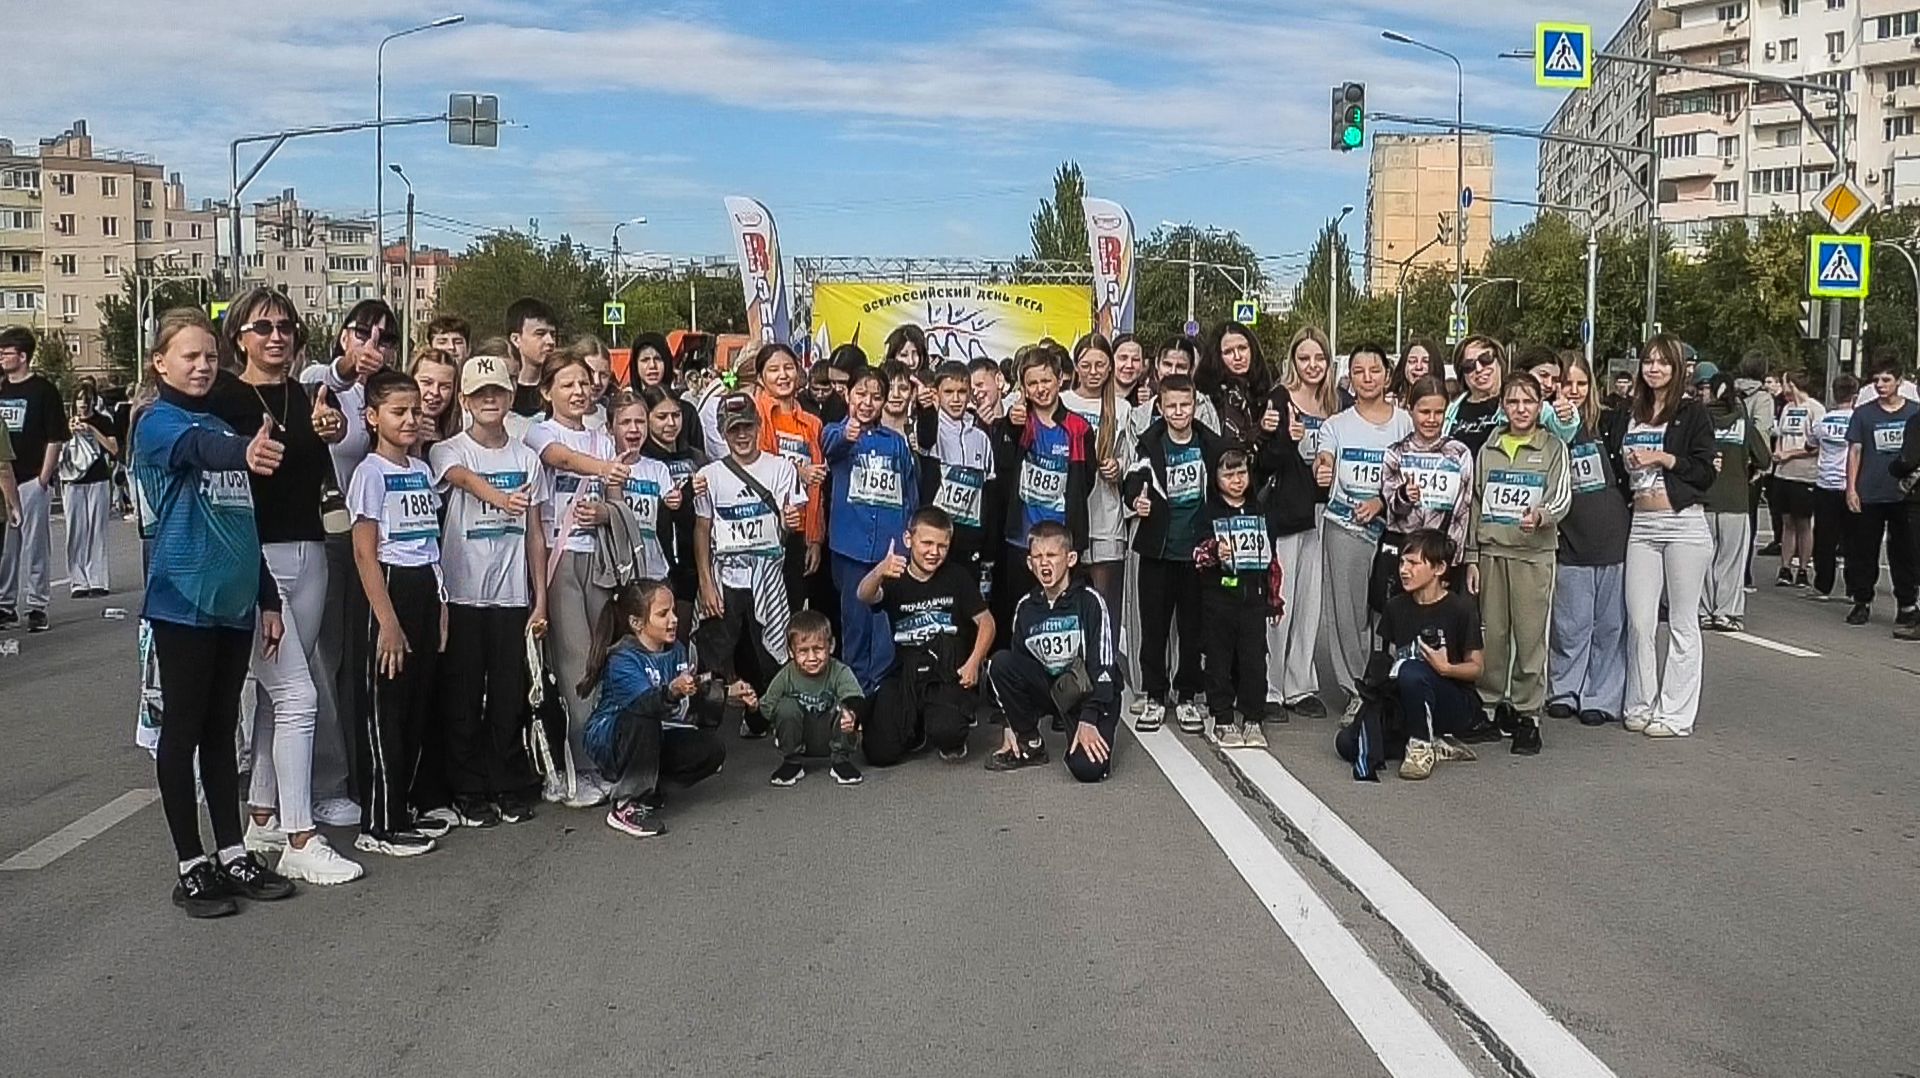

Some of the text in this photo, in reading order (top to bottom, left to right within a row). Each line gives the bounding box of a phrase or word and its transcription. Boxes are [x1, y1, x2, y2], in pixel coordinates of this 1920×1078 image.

[862, 286, 1043, 313] ВСЕРОССИЙСКИЙ ДЕНЬ БЕГА
[477, 358, 495, 374] NY
[861, 470, 896, 491] 1583
[1028, 467, 1060, 491] 1883
[400, 494, 435, 517] 1885
[1493, 486, 1530, 507] 1542
[730, 519, 763, 541] 1127
[1229, 532, 1264, 553] 1239
[1035, 634, 1071, 655] 1931
